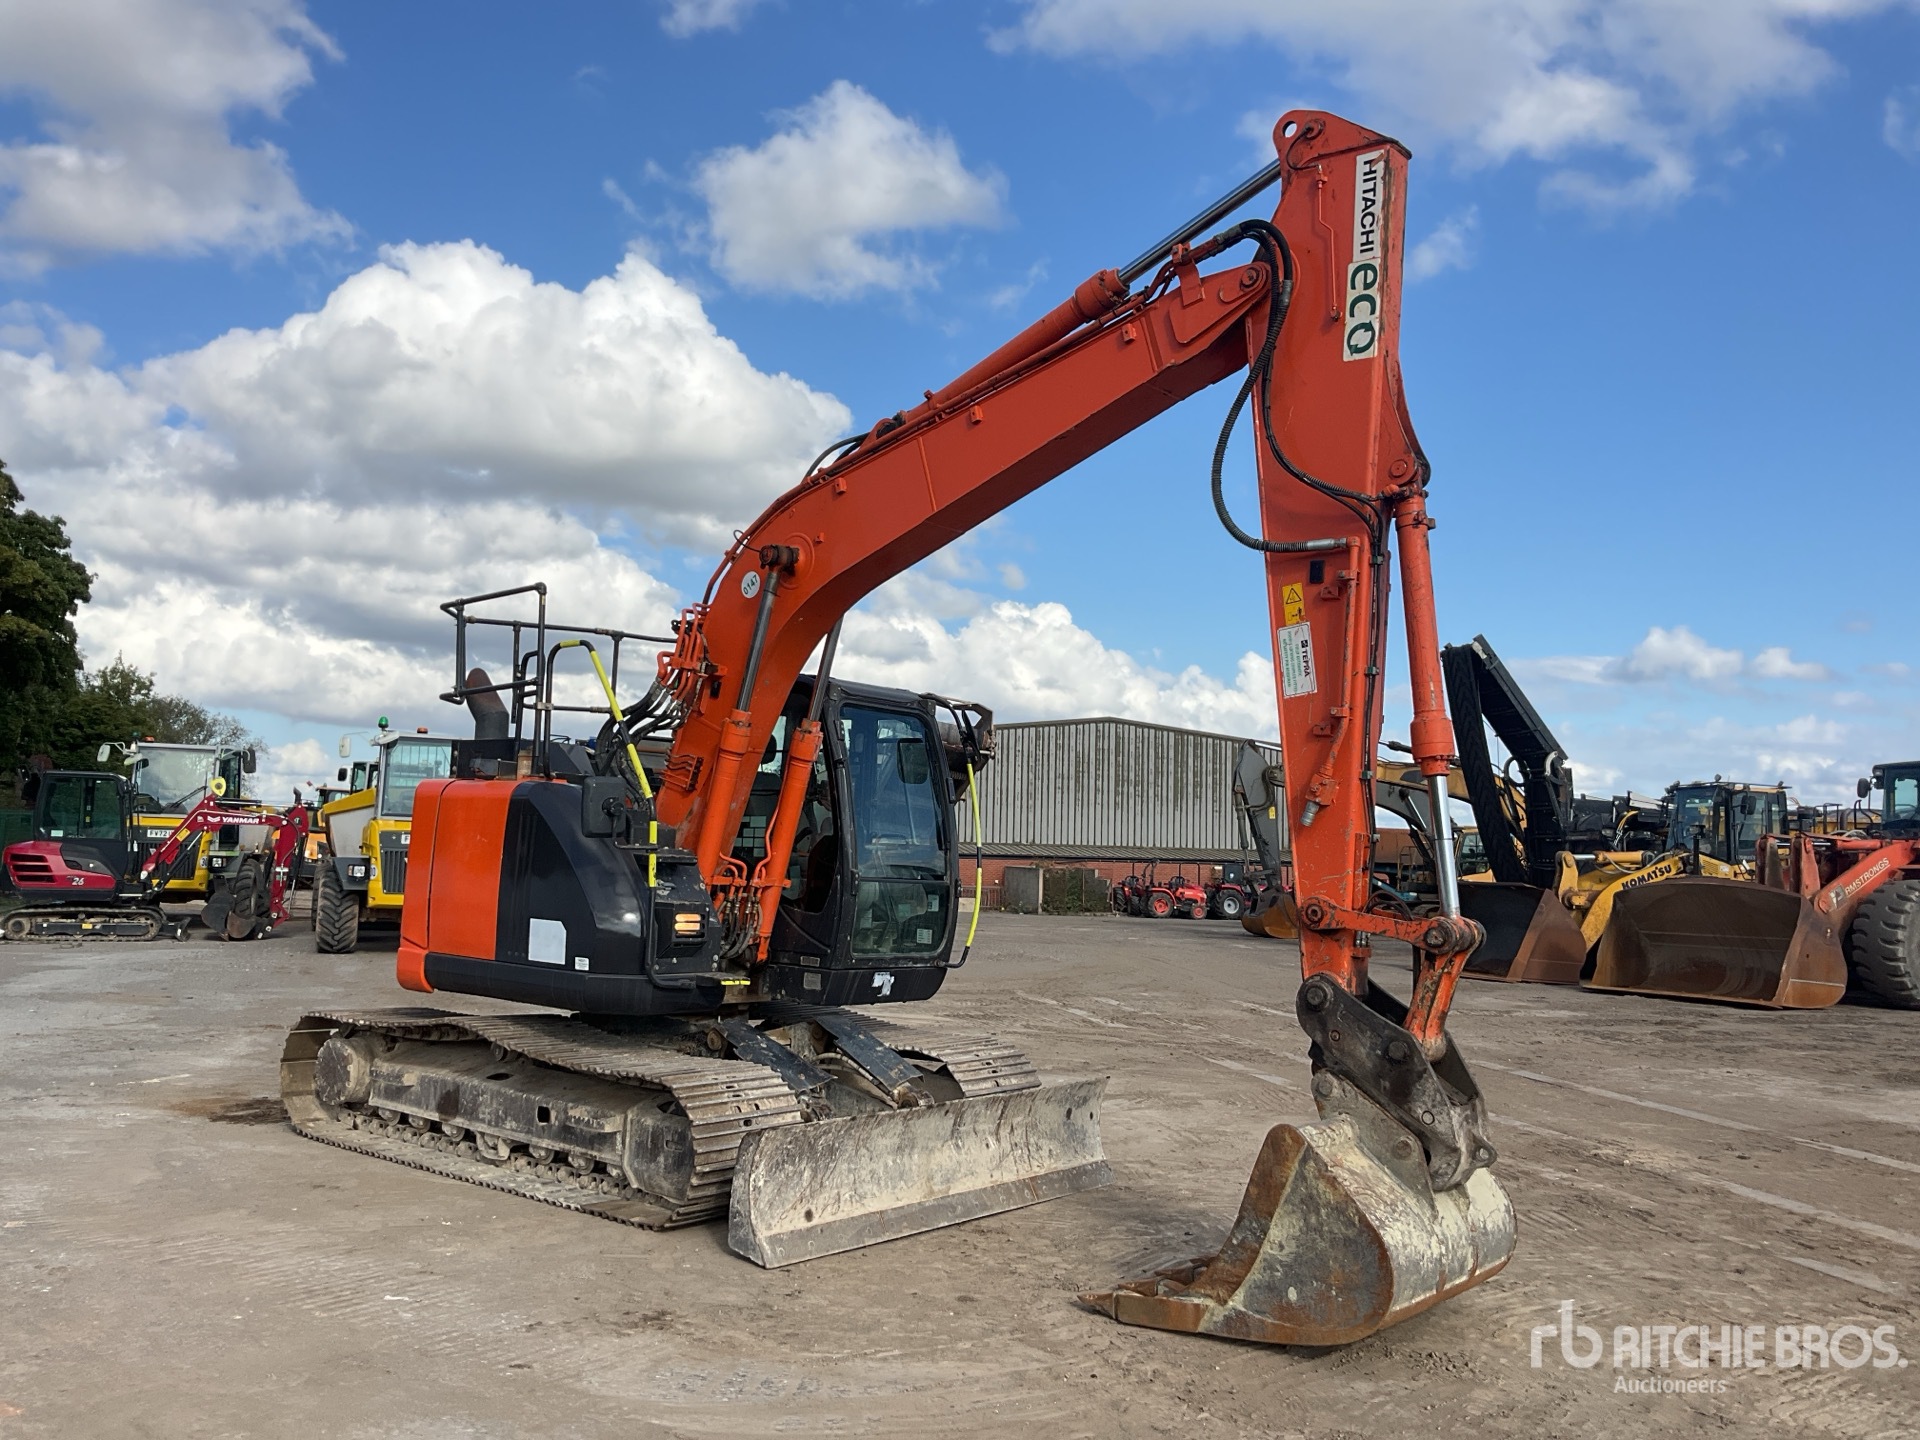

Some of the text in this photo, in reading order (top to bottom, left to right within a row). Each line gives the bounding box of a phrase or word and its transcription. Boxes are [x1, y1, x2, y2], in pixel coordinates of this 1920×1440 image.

[1359, 158, 1378, 254] HITACHI
[743, 574, 758, 595] 0147
[1302, 648, 1311, 677] TEPRA
[222, 816, 260, 824] YANMAR
[71, 877, 85, 886] 26
[1621, 864, 1672, 890] KOMATSU
